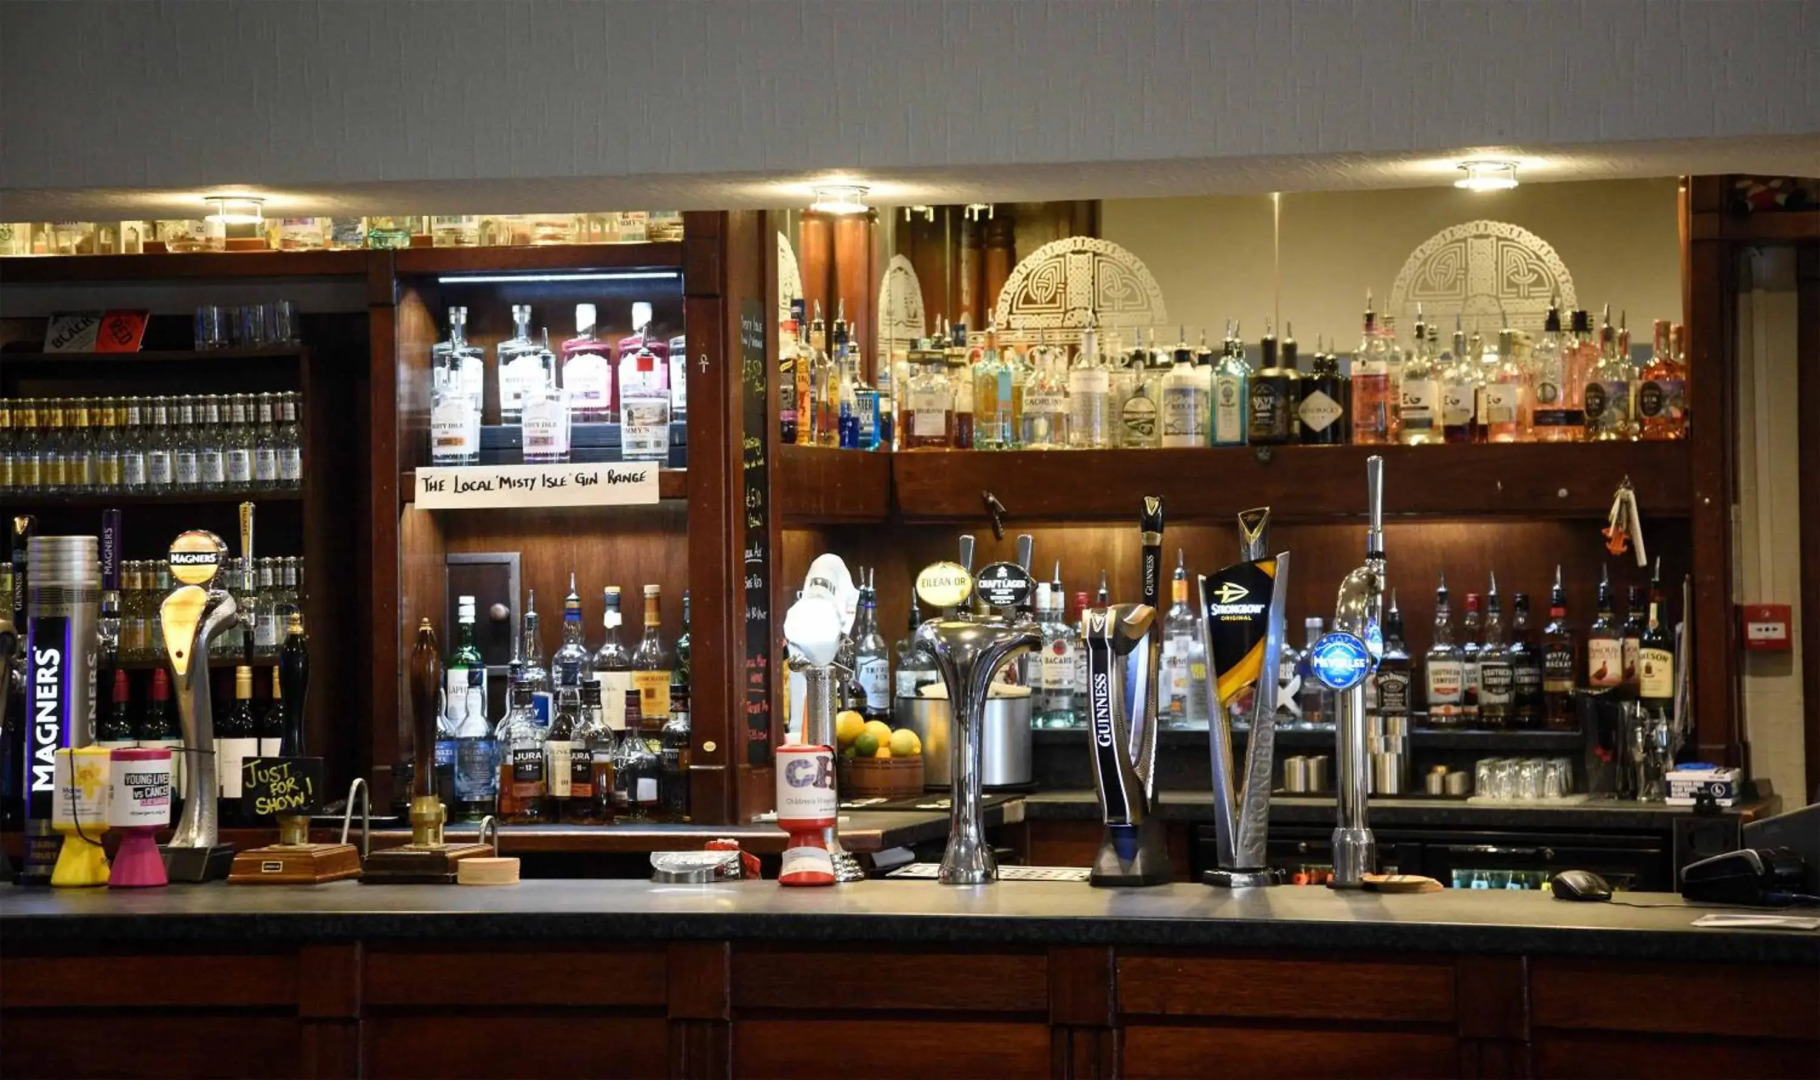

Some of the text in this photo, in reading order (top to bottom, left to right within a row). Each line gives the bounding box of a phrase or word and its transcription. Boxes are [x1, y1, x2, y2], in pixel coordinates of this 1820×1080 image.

[51, 317, 94, 349] BLACK
[108, 319, 133, 345] RED
[422, 476, 446, 492] THE
[453, 475, 494, 493] LOCAL
[575, 472, 598, 486] GIN
[607, 469, 647, 484] RANGE
[104, 527, 113, 575] MAGNERS
[170, 553, 217, 564] MAGNERS
[921, 577, 951, 588] EILEAN
[978, 580, 1026, 588] CRAFT LAGER
[1145, 554, 1155, 597] GUINNESS
[1211, 603, 1265, 616] STRONGBOW
[87, 652, 97, 740] GNERS
[32, 648, 60, 791] MAGNERS
[1095, 673, 1112, 747] GUINNESS
[515, 752, 542, 760] JURA
[126, 773, 169, 784] YOUNG LIVE
[242, 759, 292, 788] JUST
[144, 786, 168, 798] CANCE
[270, 777, 299, 796] FOR
